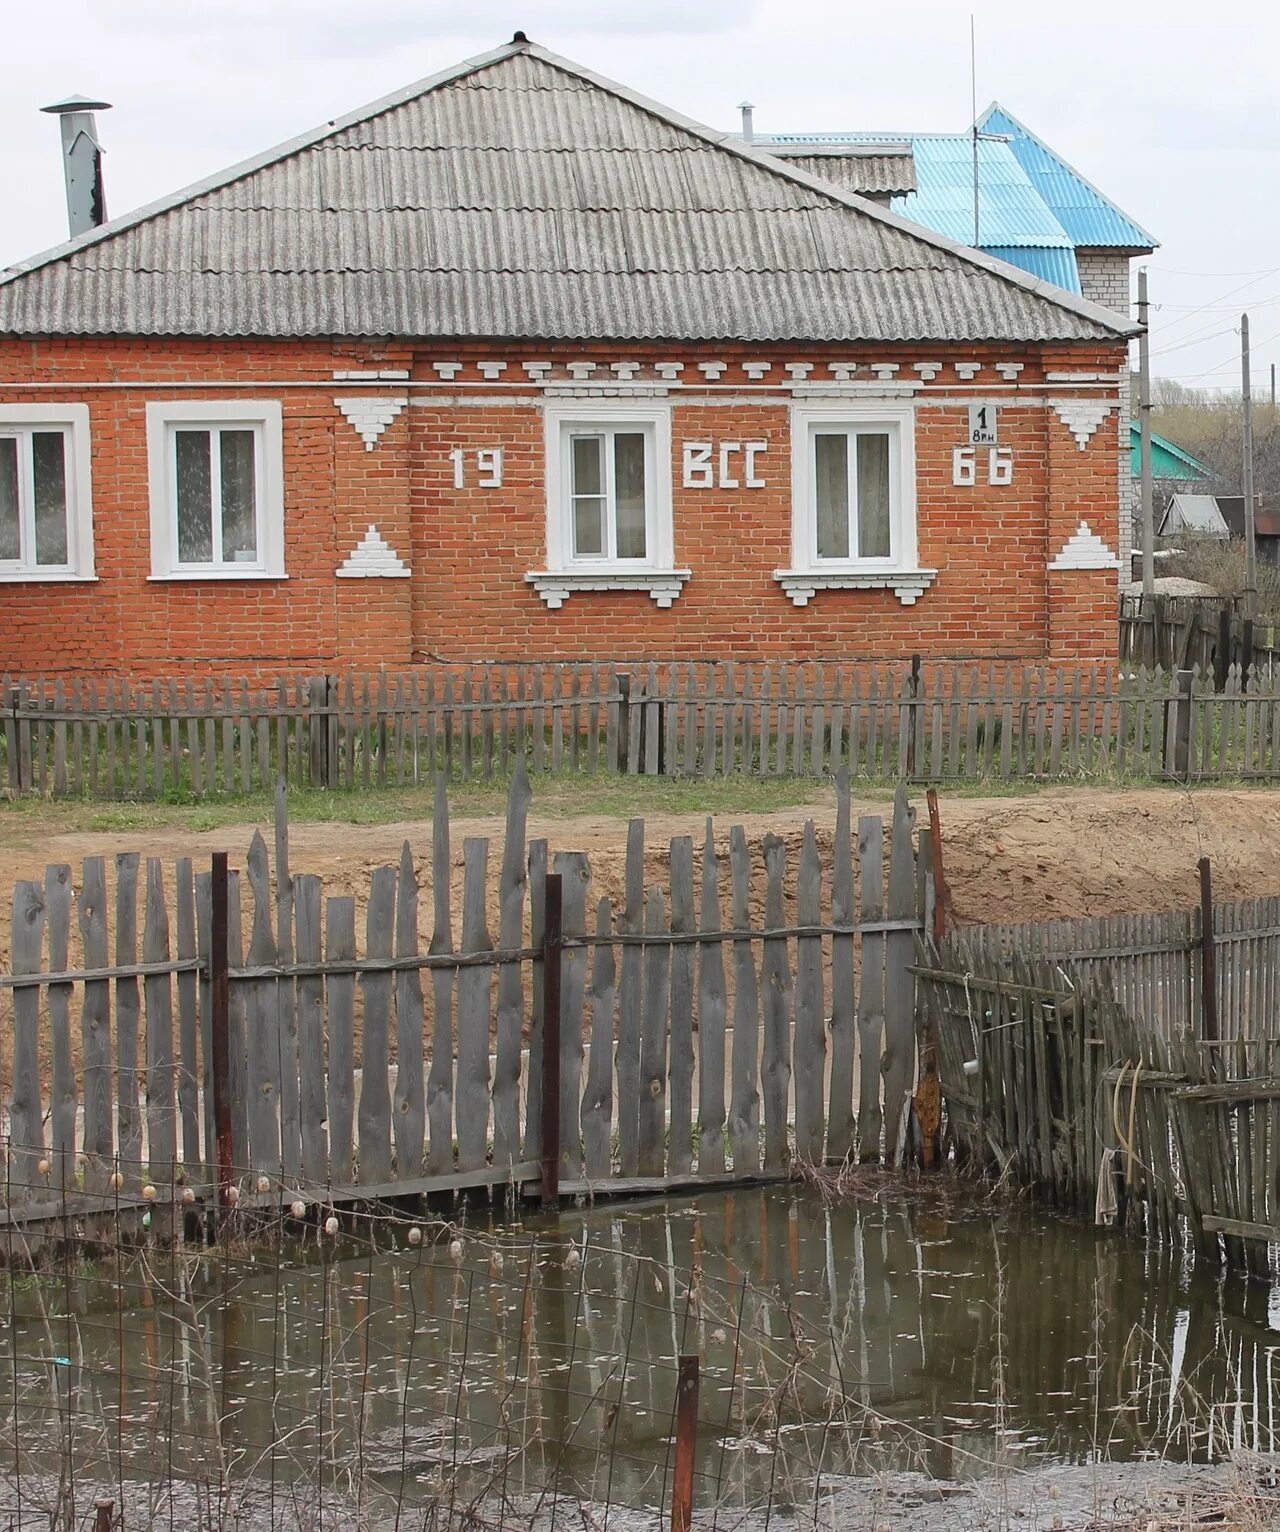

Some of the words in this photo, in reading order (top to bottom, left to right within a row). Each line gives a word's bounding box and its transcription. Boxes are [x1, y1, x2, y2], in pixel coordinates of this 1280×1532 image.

[977, 407, 987, 429] 1
[449, 449, 502, 489] 19
[682, 442, 767, 488] ВСС
[953, 448, 1012, 486] 66
